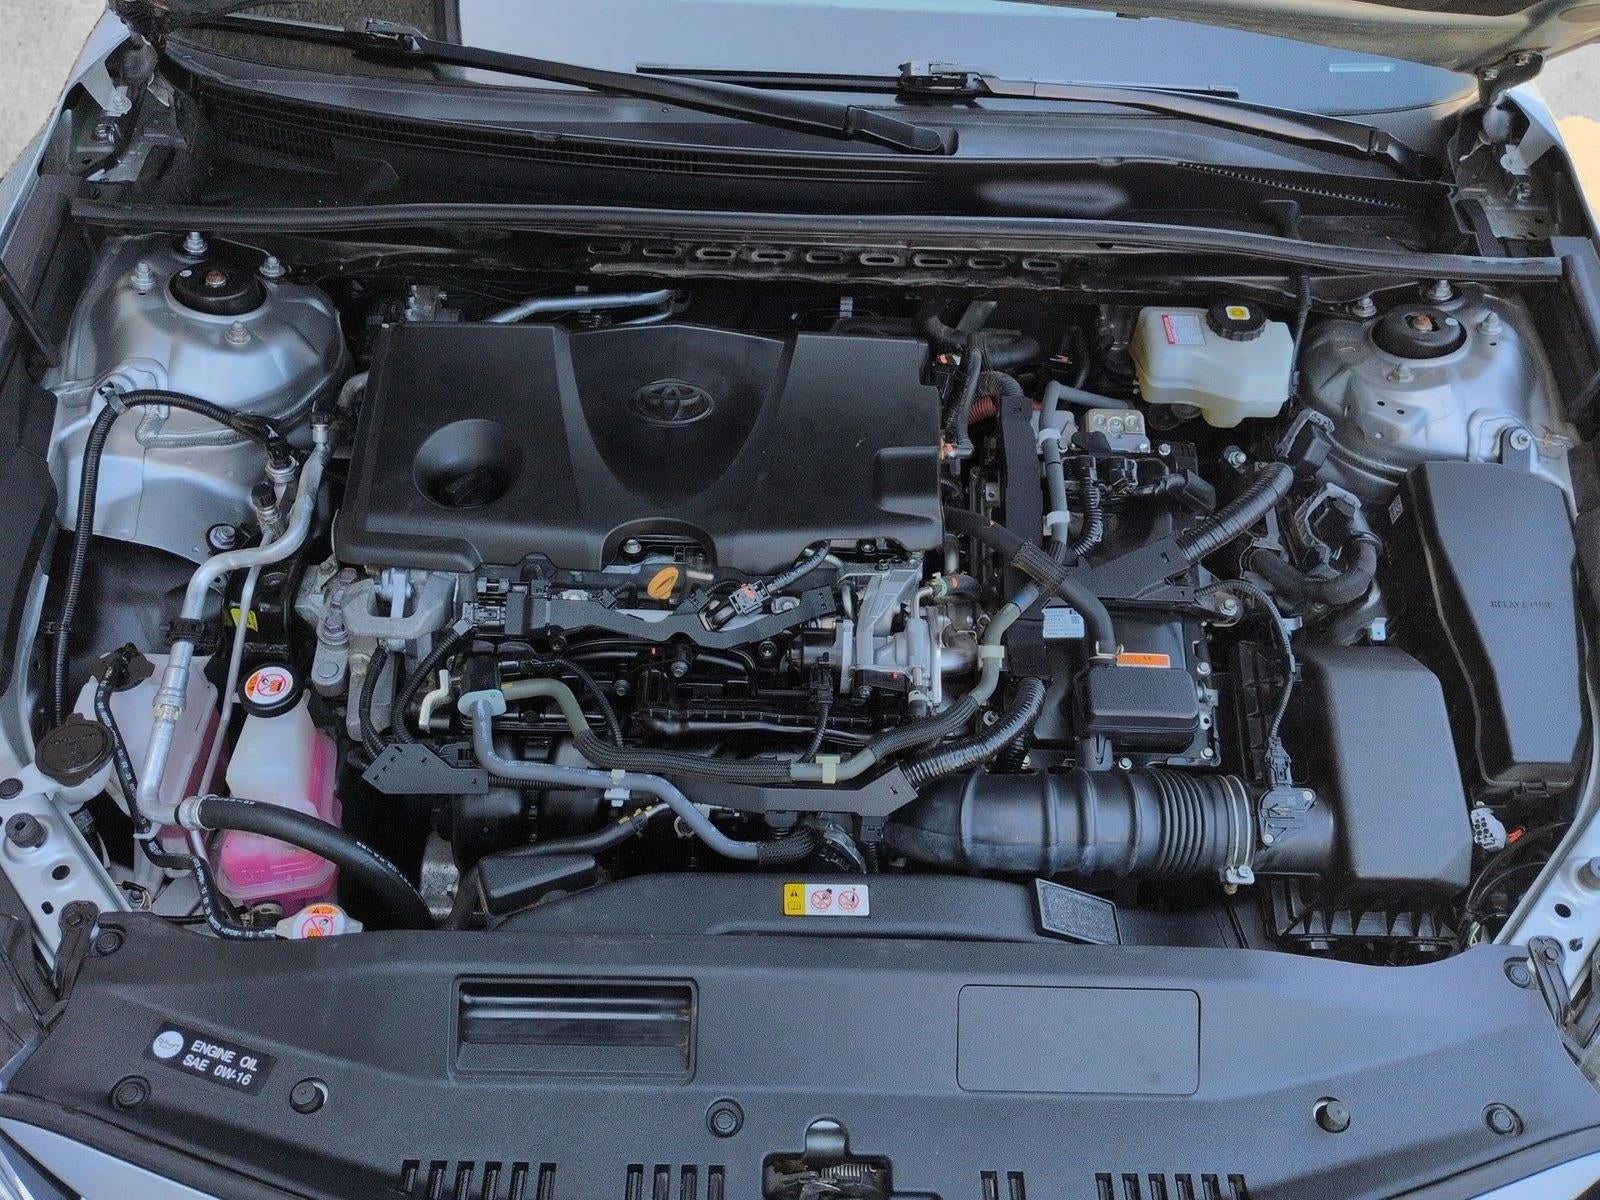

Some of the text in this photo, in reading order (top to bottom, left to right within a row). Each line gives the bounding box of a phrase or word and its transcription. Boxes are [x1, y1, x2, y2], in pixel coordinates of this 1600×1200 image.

[182, 1054, 252, 1085] SAE 0W-16
[191, 1040, 258, 1071] ENGINE OIL
